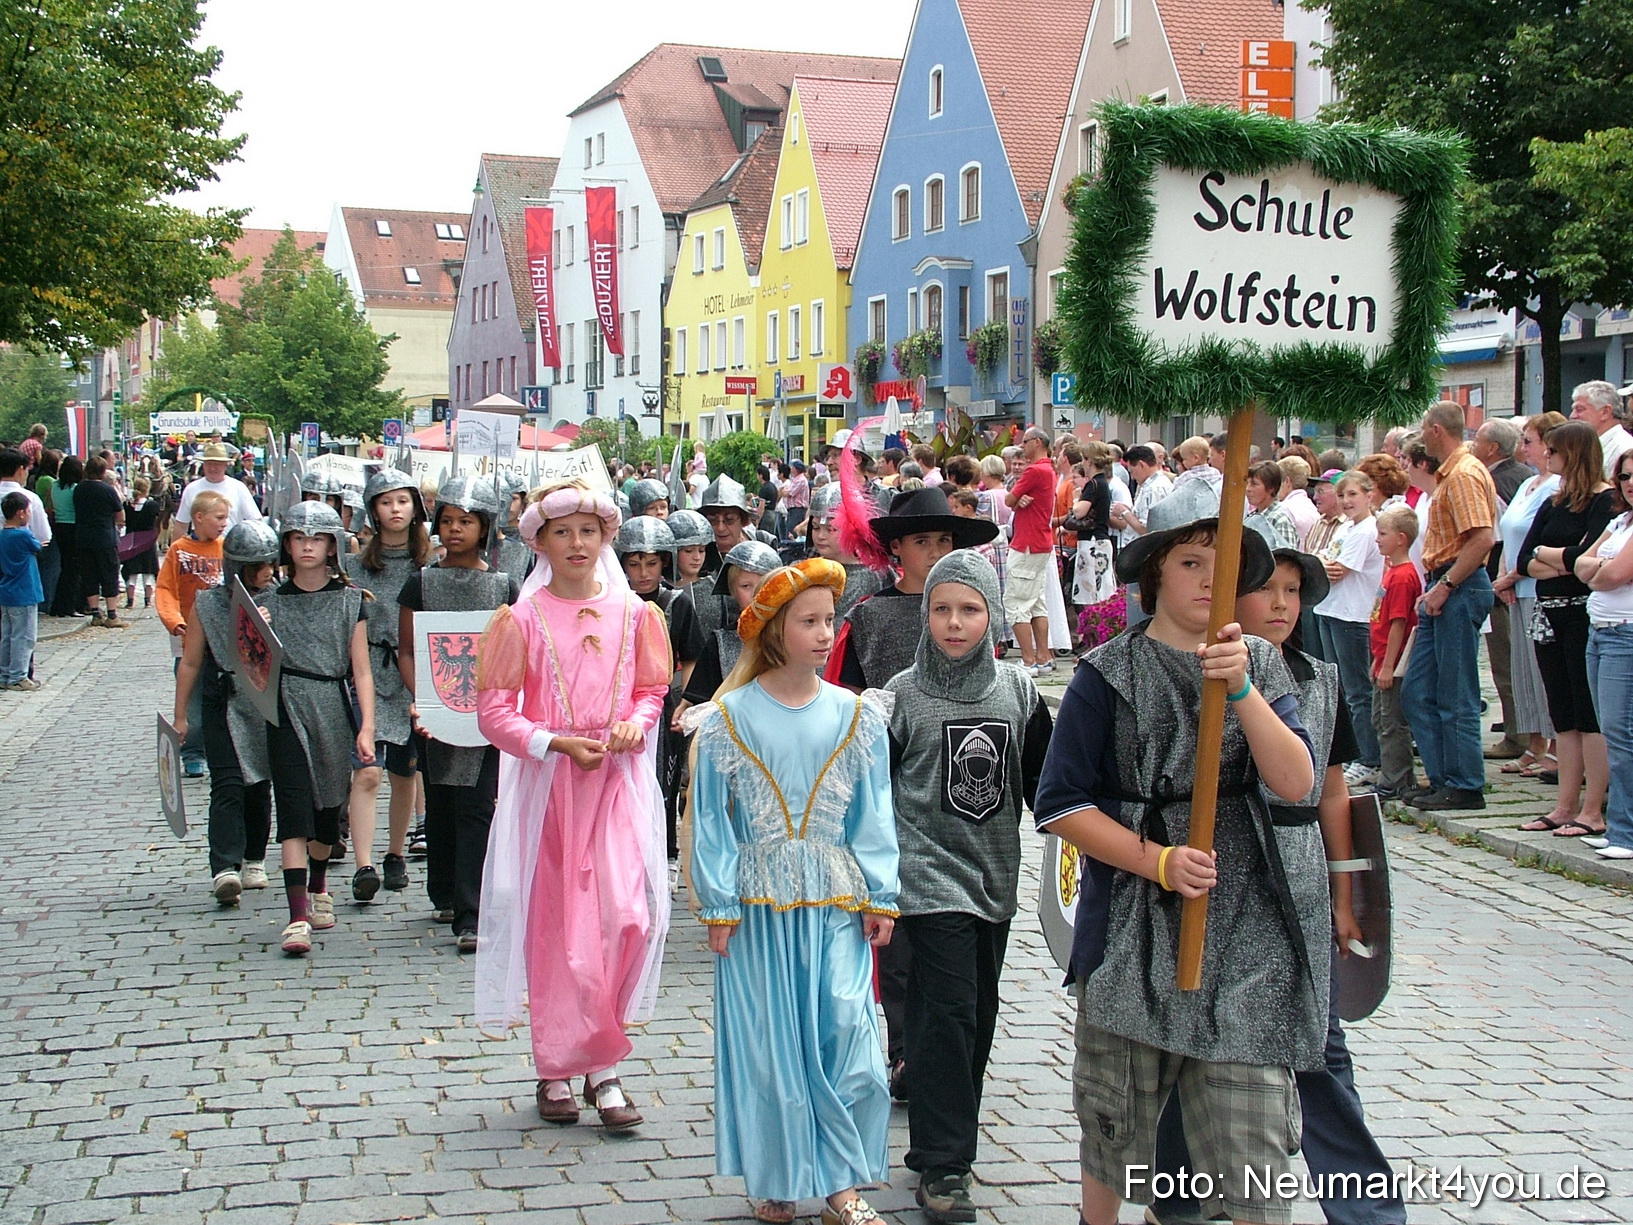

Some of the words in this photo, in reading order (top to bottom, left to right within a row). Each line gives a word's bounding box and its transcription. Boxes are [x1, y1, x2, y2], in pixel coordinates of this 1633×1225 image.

[1193, 170, 1354, 240] Schule
[703, 295, 726, 316] HOTEL
[1153, 266, 1377, 334] Wolfstein
[1057, 376, 1071, 402] P
[158, 415, 202, 428] Grundschule
